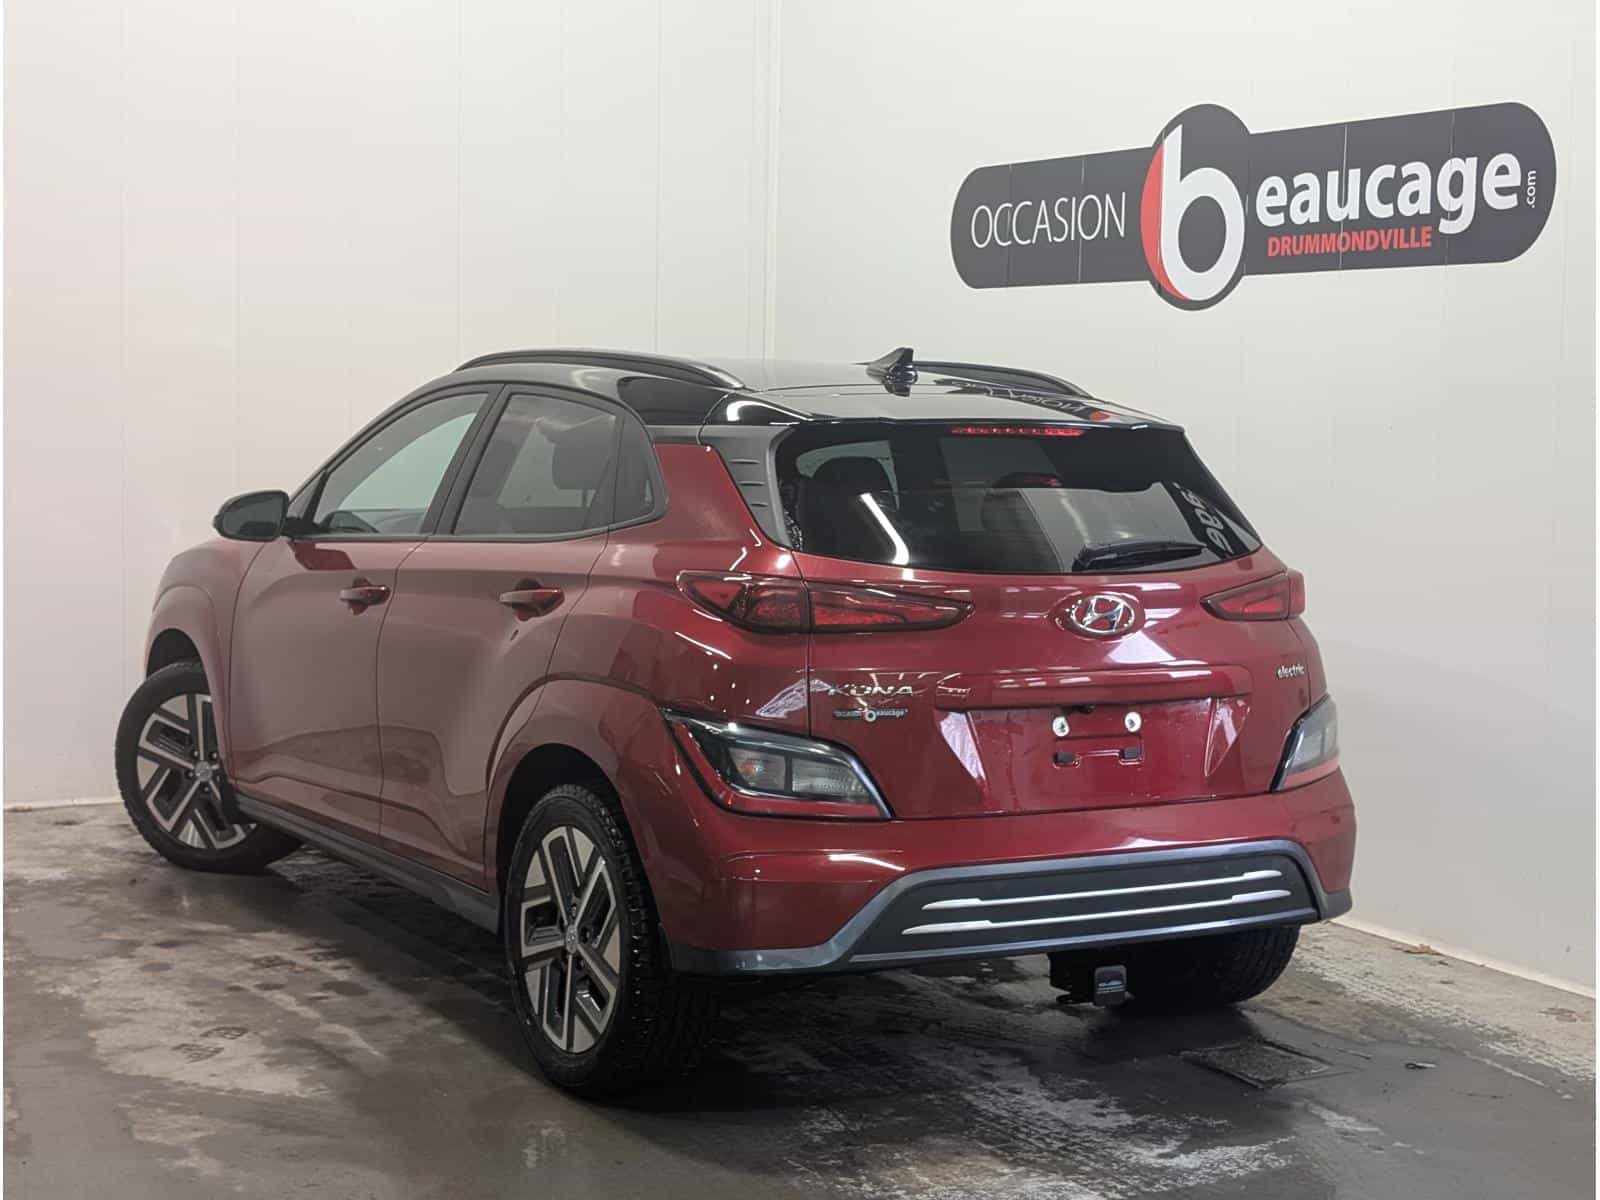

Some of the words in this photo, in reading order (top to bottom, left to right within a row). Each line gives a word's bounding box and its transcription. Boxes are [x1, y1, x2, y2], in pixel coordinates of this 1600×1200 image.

[970, 191, 1127, 249] OCCASION
[1266, 226, 1433, 257] DRUMMONDVILLE
[1277, 664, 1305, 679] electric
[827, 683, 914, 697] KONA
